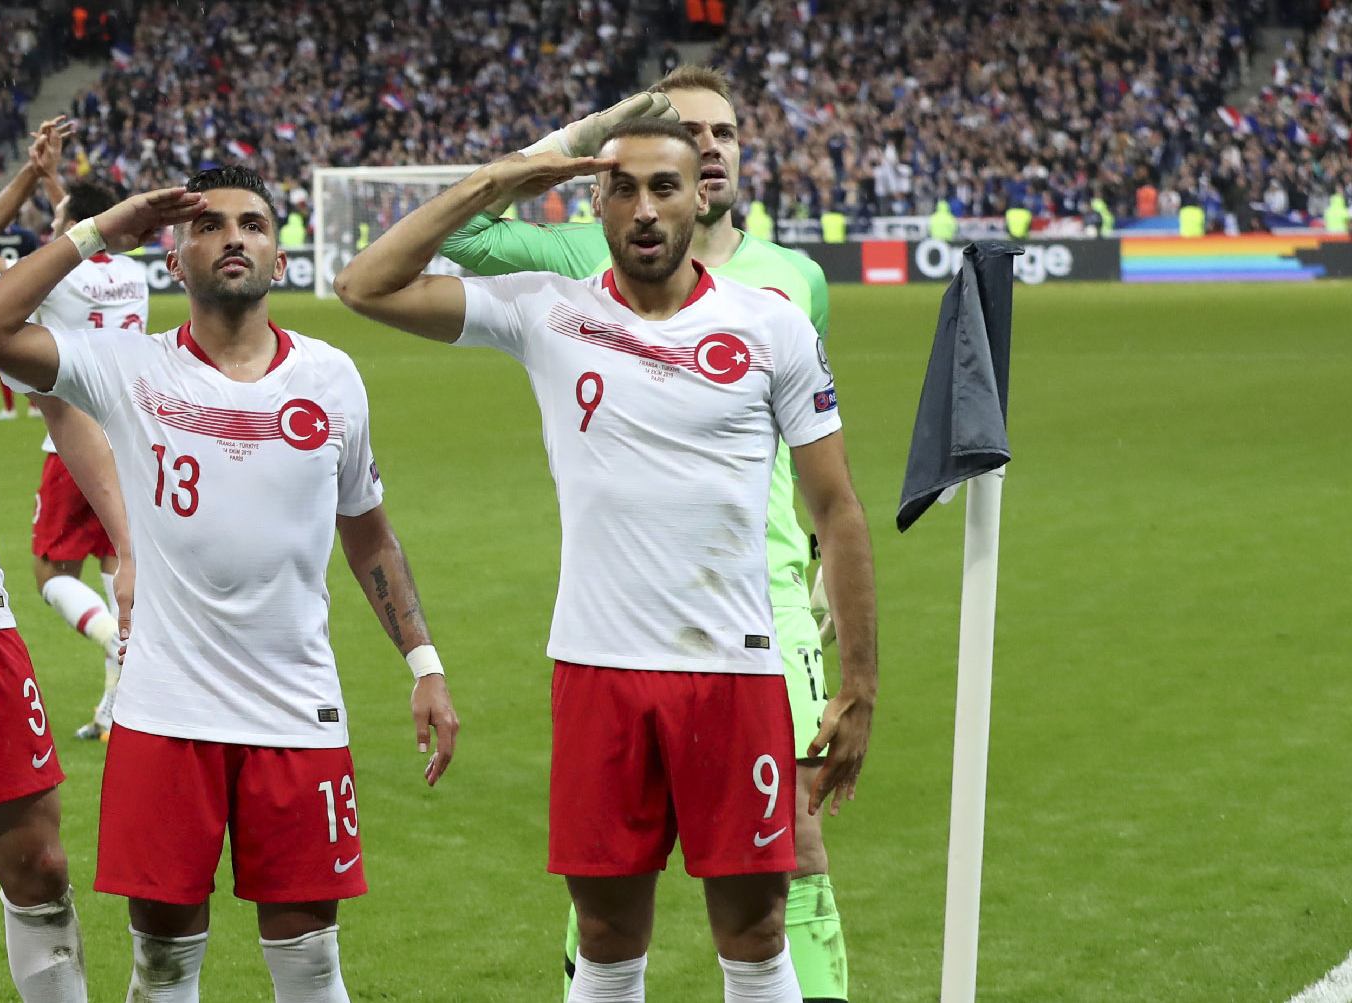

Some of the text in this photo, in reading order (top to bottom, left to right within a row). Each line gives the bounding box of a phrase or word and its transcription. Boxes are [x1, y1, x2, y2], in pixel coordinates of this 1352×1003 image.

[575, 371, 604, 433] 9
[151, 443, 201, 518] 13
[797, 647, 830, 701] 1
[22, 677, 47, 737] 3
[317, 774, 358, 843] 13
[752, 753, 780, 819] 9
